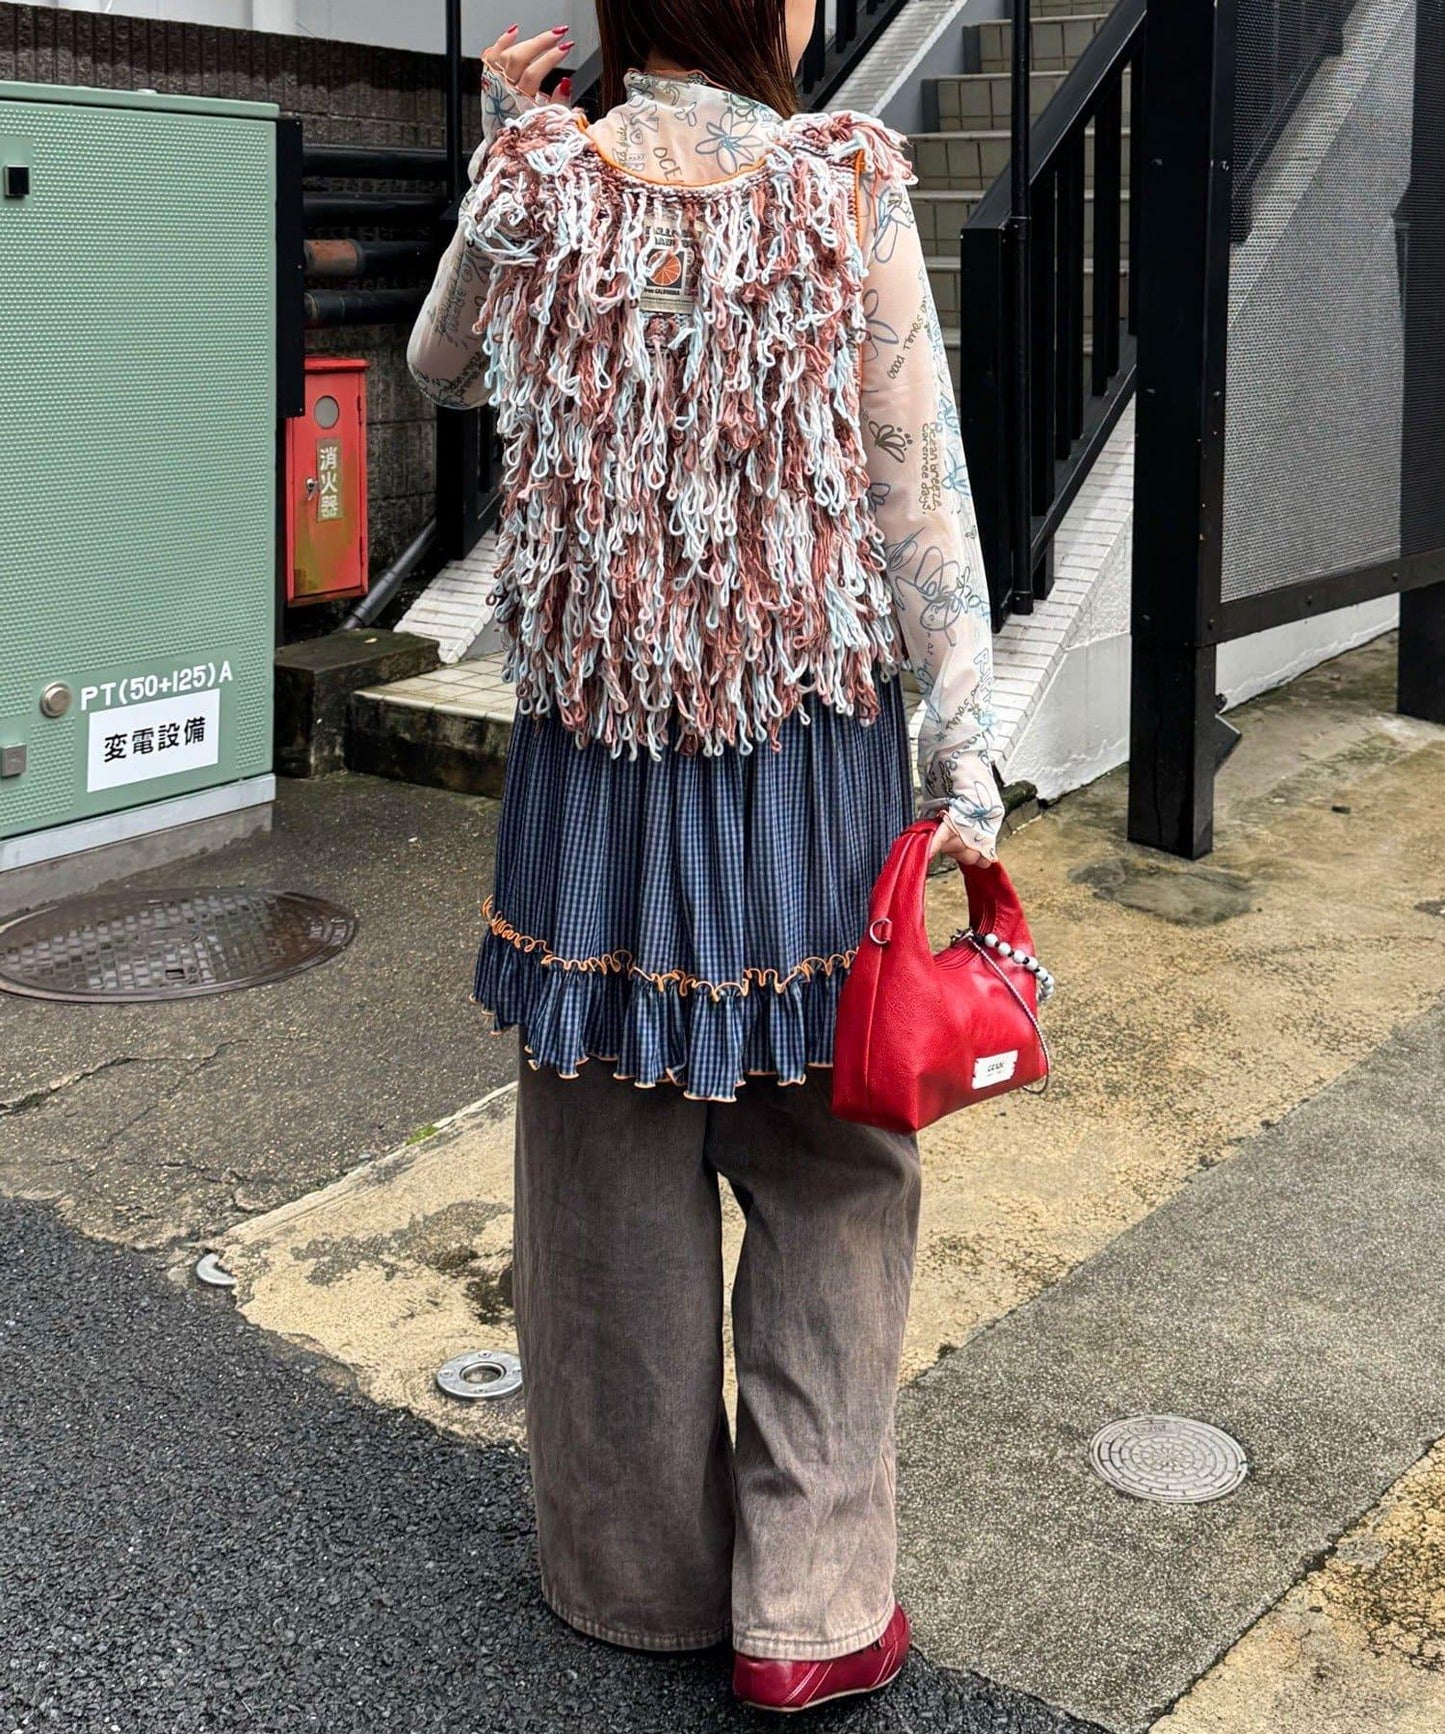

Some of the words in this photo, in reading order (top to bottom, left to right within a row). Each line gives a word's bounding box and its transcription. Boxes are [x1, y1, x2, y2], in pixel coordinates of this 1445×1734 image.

[653, 146, 685, 183] OCE
[319, 446, 339, 517] 消火器
[103, 716, 207, 764] 変電設備
